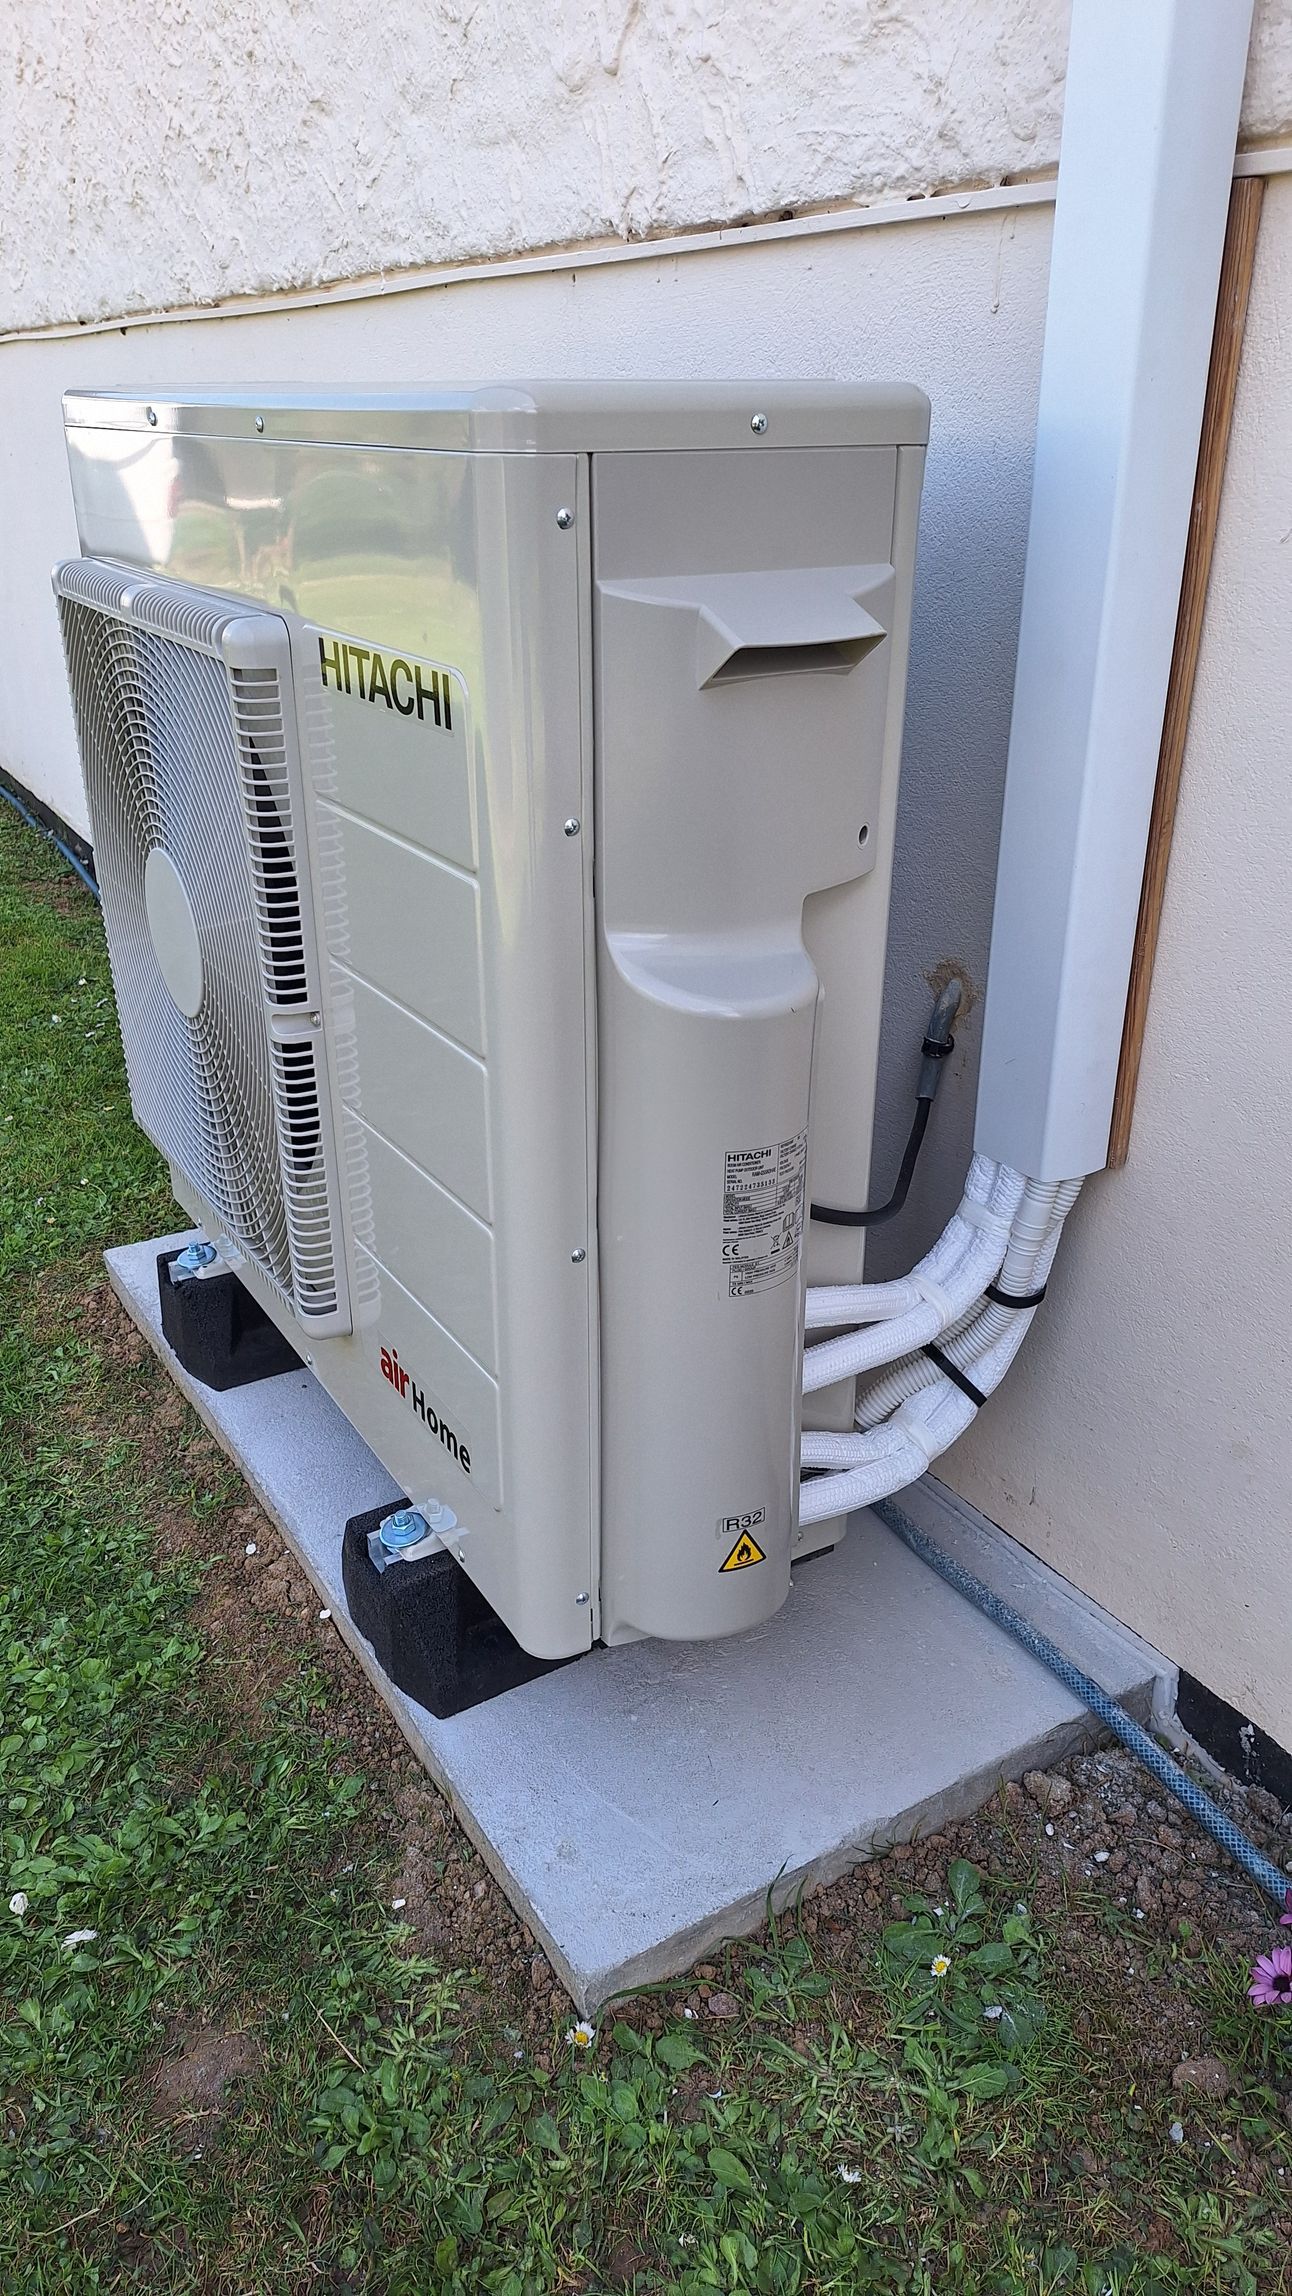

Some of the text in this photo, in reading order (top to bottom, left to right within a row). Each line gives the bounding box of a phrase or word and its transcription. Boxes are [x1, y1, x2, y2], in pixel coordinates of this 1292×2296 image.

[318, 637, 452, 730] HITACHI
[728, 1149, 771, 1162] HITACHI
[726, 1511, 762, 1531] R32
